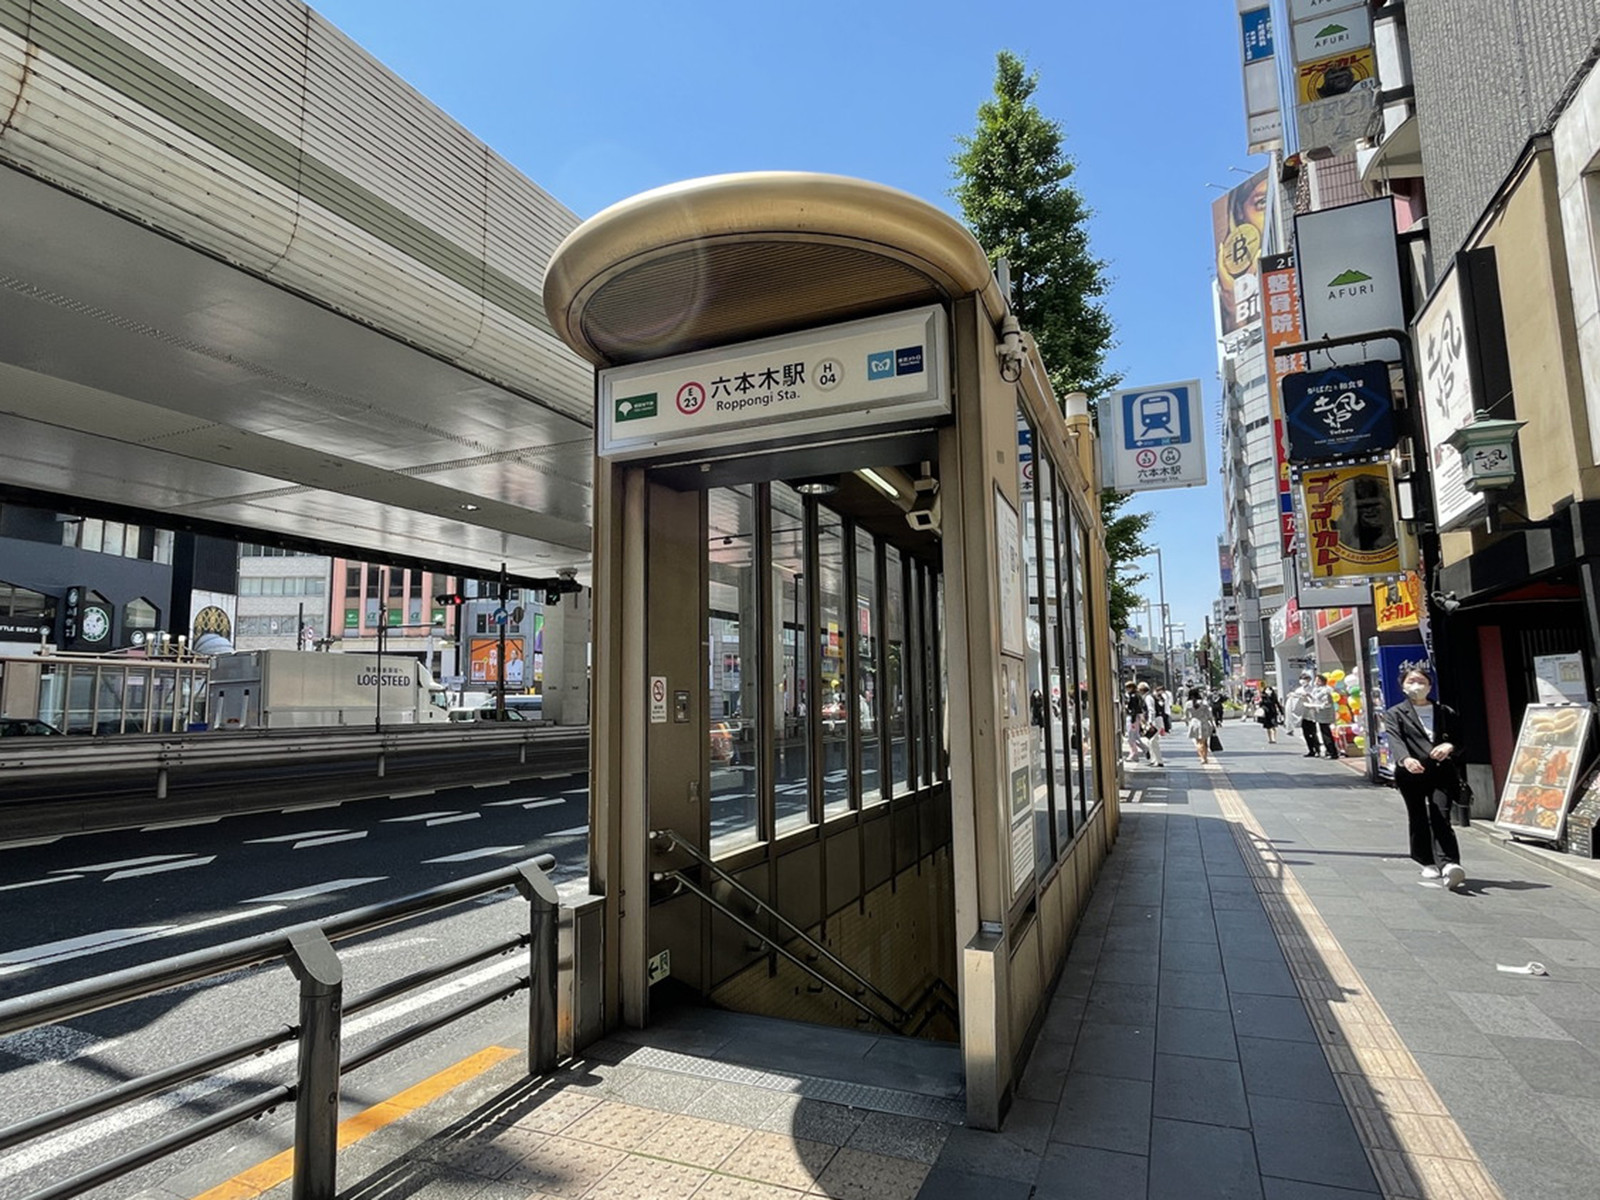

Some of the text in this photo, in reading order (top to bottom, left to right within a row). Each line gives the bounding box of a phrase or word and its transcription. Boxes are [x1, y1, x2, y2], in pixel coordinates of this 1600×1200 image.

[1315, 34, 1349, 48] AFURI
[1328, 284, 1374, 300] AFURI
[823, 363, 832, 373] H
[711, 362, 806, 399] 六本木駅
[819, 373, 836, 385] 04
[688, 387, 694, 397] E
[684, 396, 698, 409] 23
[716, 389, 801, 412] Roppongi Sta.
[1137, 466, 1182, 478] 六本木駅
[357, 674, 411, 687] LOGSTEED
